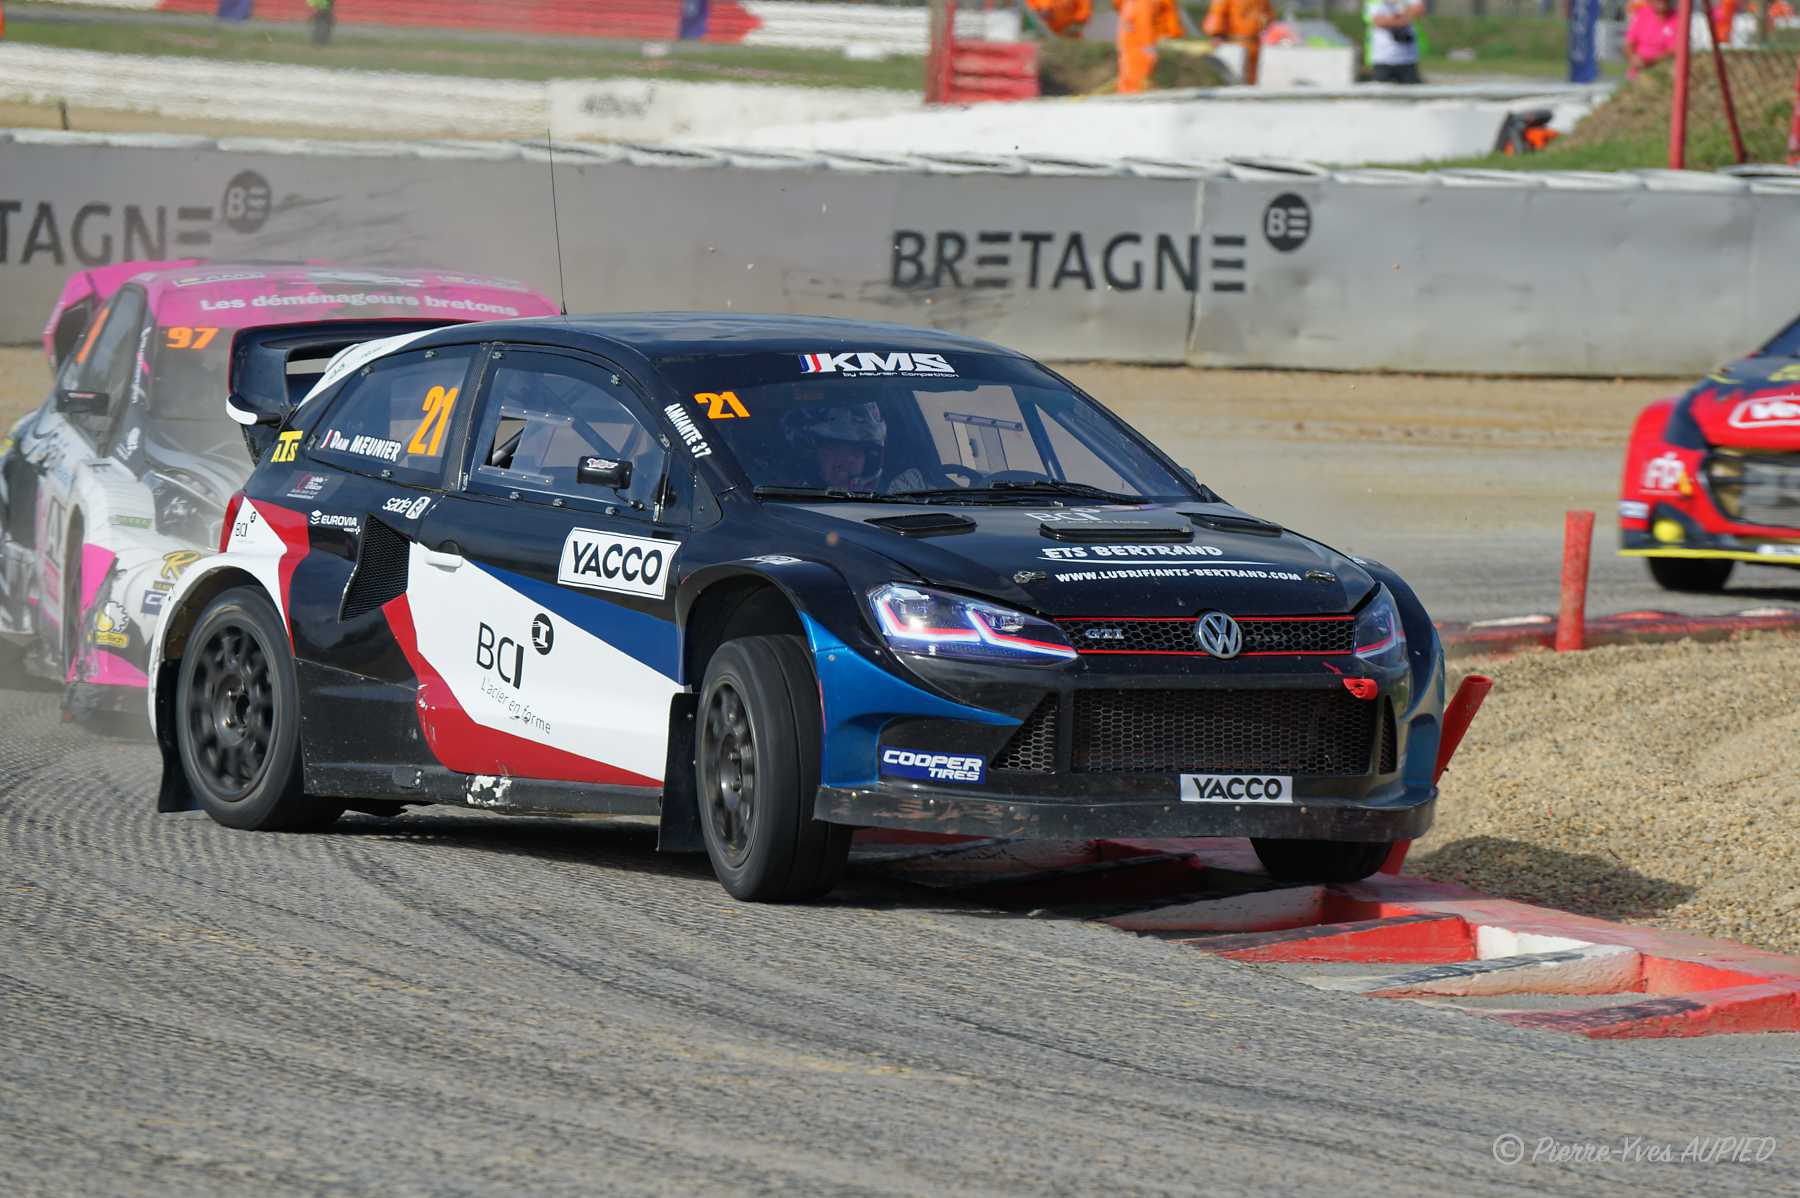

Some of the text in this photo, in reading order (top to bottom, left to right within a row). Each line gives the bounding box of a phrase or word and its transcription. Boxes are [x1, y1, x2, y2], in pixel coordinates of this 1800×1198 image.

[891, 230, 1246, 293] BRETAGNE
[201, 291, 519, 317] Les déménageurs bretons
[166, 326, 219, 350] 97
[819, 352, 956, 374] KMS
[694, 391, 751, 419] 21
[408, 386, 459, 457] 21
[664, 403, 712, 459] AMIANTE 37
[349, 434, 402, 463] MEUNIER
[320, 514, 358, 527] EUROVIA
[573, 541, 663, 586] YACCO
[1042, 545, 1223, 560] ETS BERTRAND
[1055, 568, 1302, 583] WWW.LUBRIFIANTS-BERTRAND.COM
[1085, 628, 1125, 640] GTI
[476, 621, 525, 690] BCI
[508, 699, 521, 714] en
[521, 704, 552, 735] forme
[883, 750, 983, 771] COOPER
[928, 768, 980, 781] TIRES
[1192, 777, 1283, 801] YACCO
